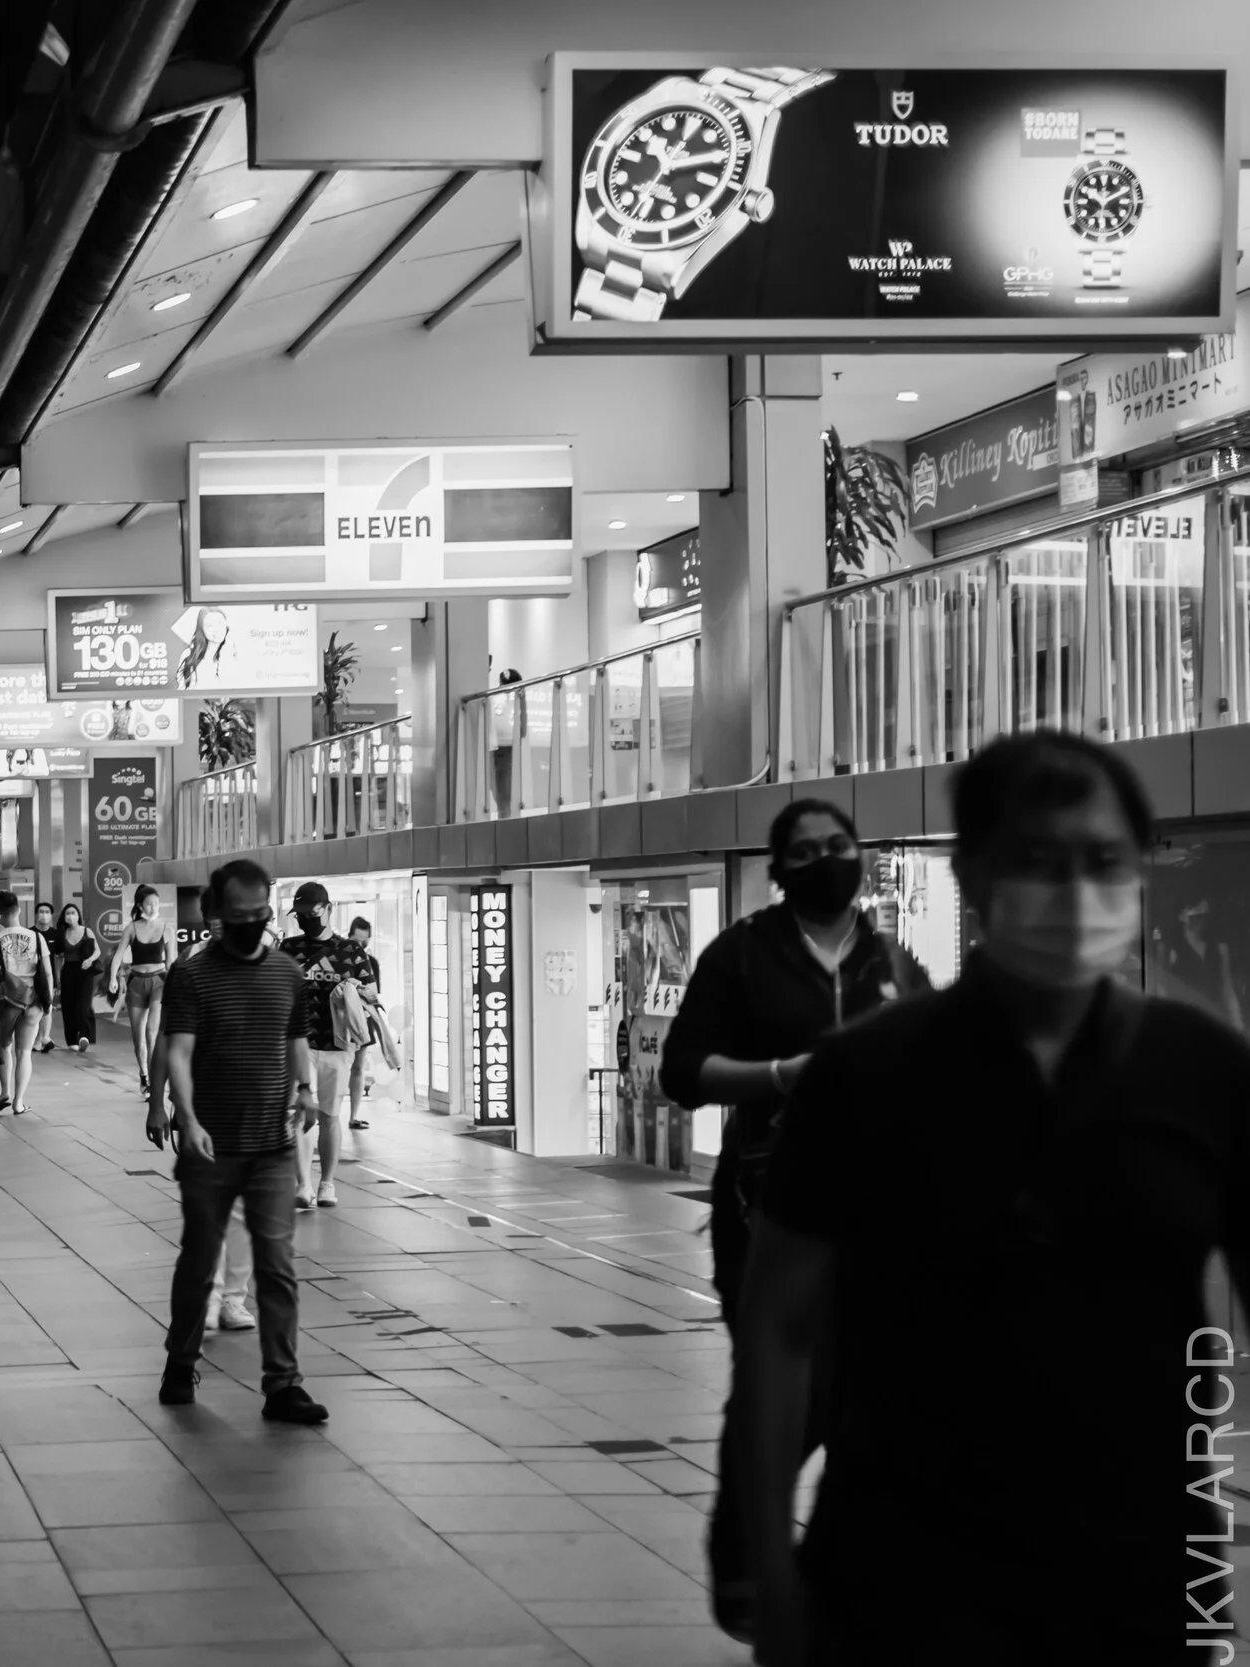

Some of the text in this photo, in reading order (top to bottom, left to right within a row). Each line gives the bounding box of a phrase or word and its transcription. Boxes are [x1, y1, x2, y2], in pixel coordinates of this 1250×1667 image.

[1024, 112, 1079, 126] #BORN
[855, 122, 949, 147] TUDOR
[848, 255, 952, 270] WATCH PALACE
[1106, 332, 1236, 406] ASAGAO MINIMART
[1123, 371, 1222, 426] アサガオミニマート
[940, 413, 1058, 488] Killiney Kopiti
[73, 625, 143, 636] SIM ONLY PLAN
[250, 628, 309, 639] Sign up now!
[73, 634, 168, 671] 130 GB
[30, 671, 46, 687] th
[17, 689, 47, 705] dat
[111, 772, 145, 786] Singtel
[95, 795, 132, 821] 60
[104, 878, 123, 887] 300
[482, 892, 507, 983] MONEY
[303, 969, 342, 983] didas
[485, 991, 509, 1118] CHANGER
